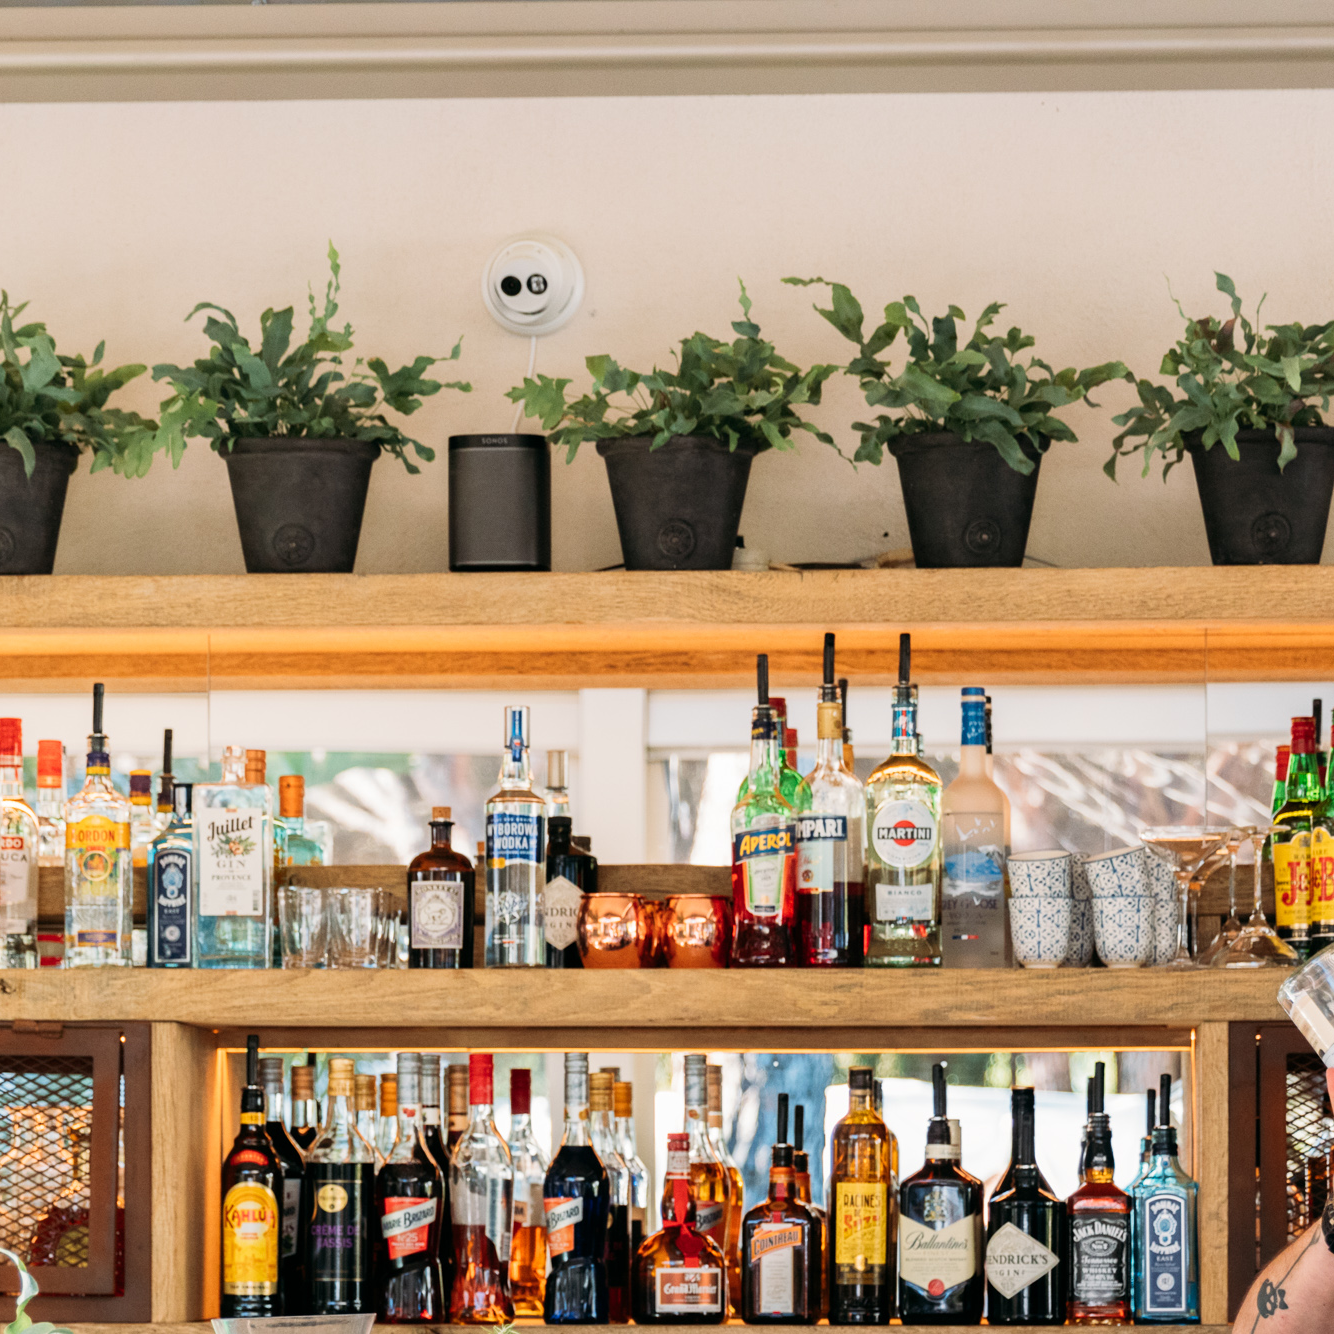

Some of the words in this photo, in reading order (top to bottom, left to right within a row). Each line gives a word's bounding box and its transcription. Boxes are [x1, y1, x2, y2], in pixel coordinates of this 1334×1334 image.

[207, 816, 254, 841] Juillet
[487, 823, 539, 836] WYBOROWA
[797, 818, 844, 838] MPARI
[878, 828, 931, 839] MARTINI
[739, 832, 792, 857] APEROL
[216, 860, 247, 869] GIN
[544, 907, 579, 918] NDRIC
[843, 1194, 881, 1208] RACINES
[225, 1204, 276, 1229] KAHLÚA
[1073, 1224, 1095, 1243] JACK
[753, 1230, 799, 1256] COINTREAU
[986, 1253, 1048, 1266] ENDRICK'S
[999, 1269, 1020, 1277] GIN
